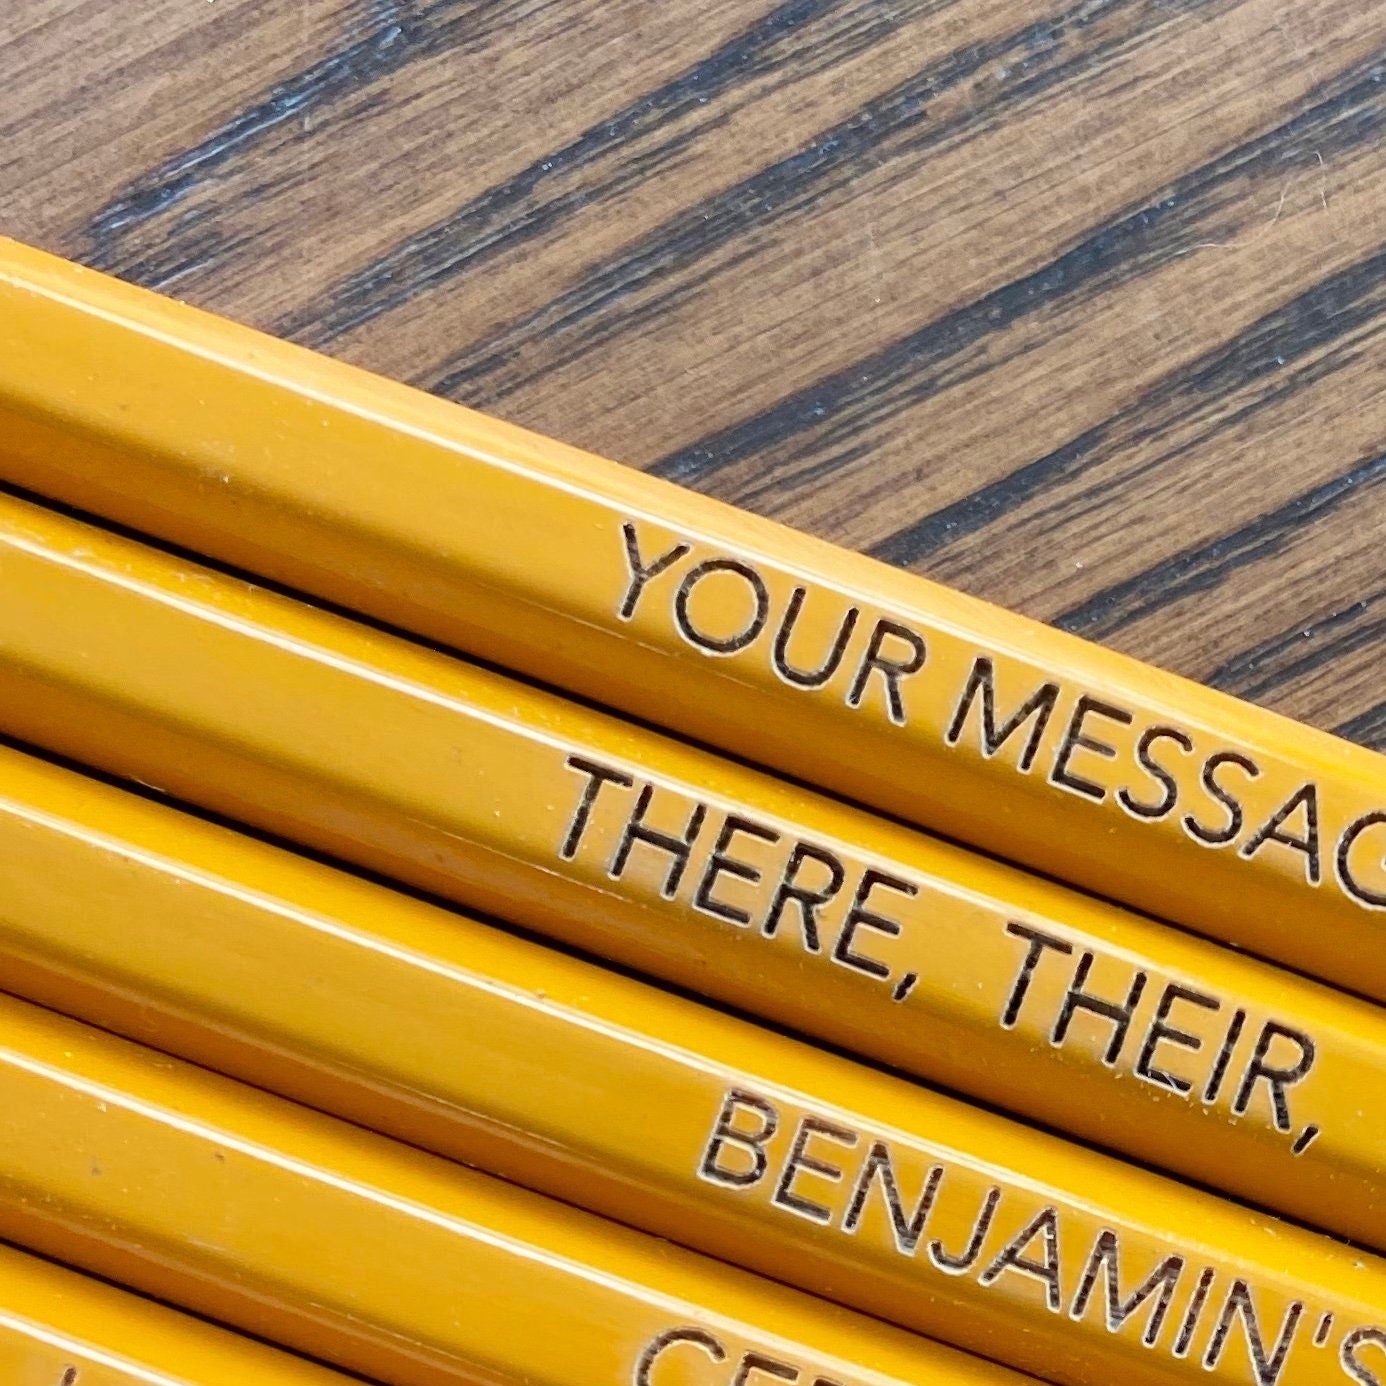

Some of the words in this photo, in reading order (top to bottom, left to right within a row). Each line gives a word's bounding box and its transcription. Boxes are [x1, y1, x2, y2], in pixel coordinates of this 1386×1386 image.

[615, 520, 926, 725] YOUR
[558, 753, 919, 1002] THERE,
[998, 921, 1318, 1158] THEIR,
